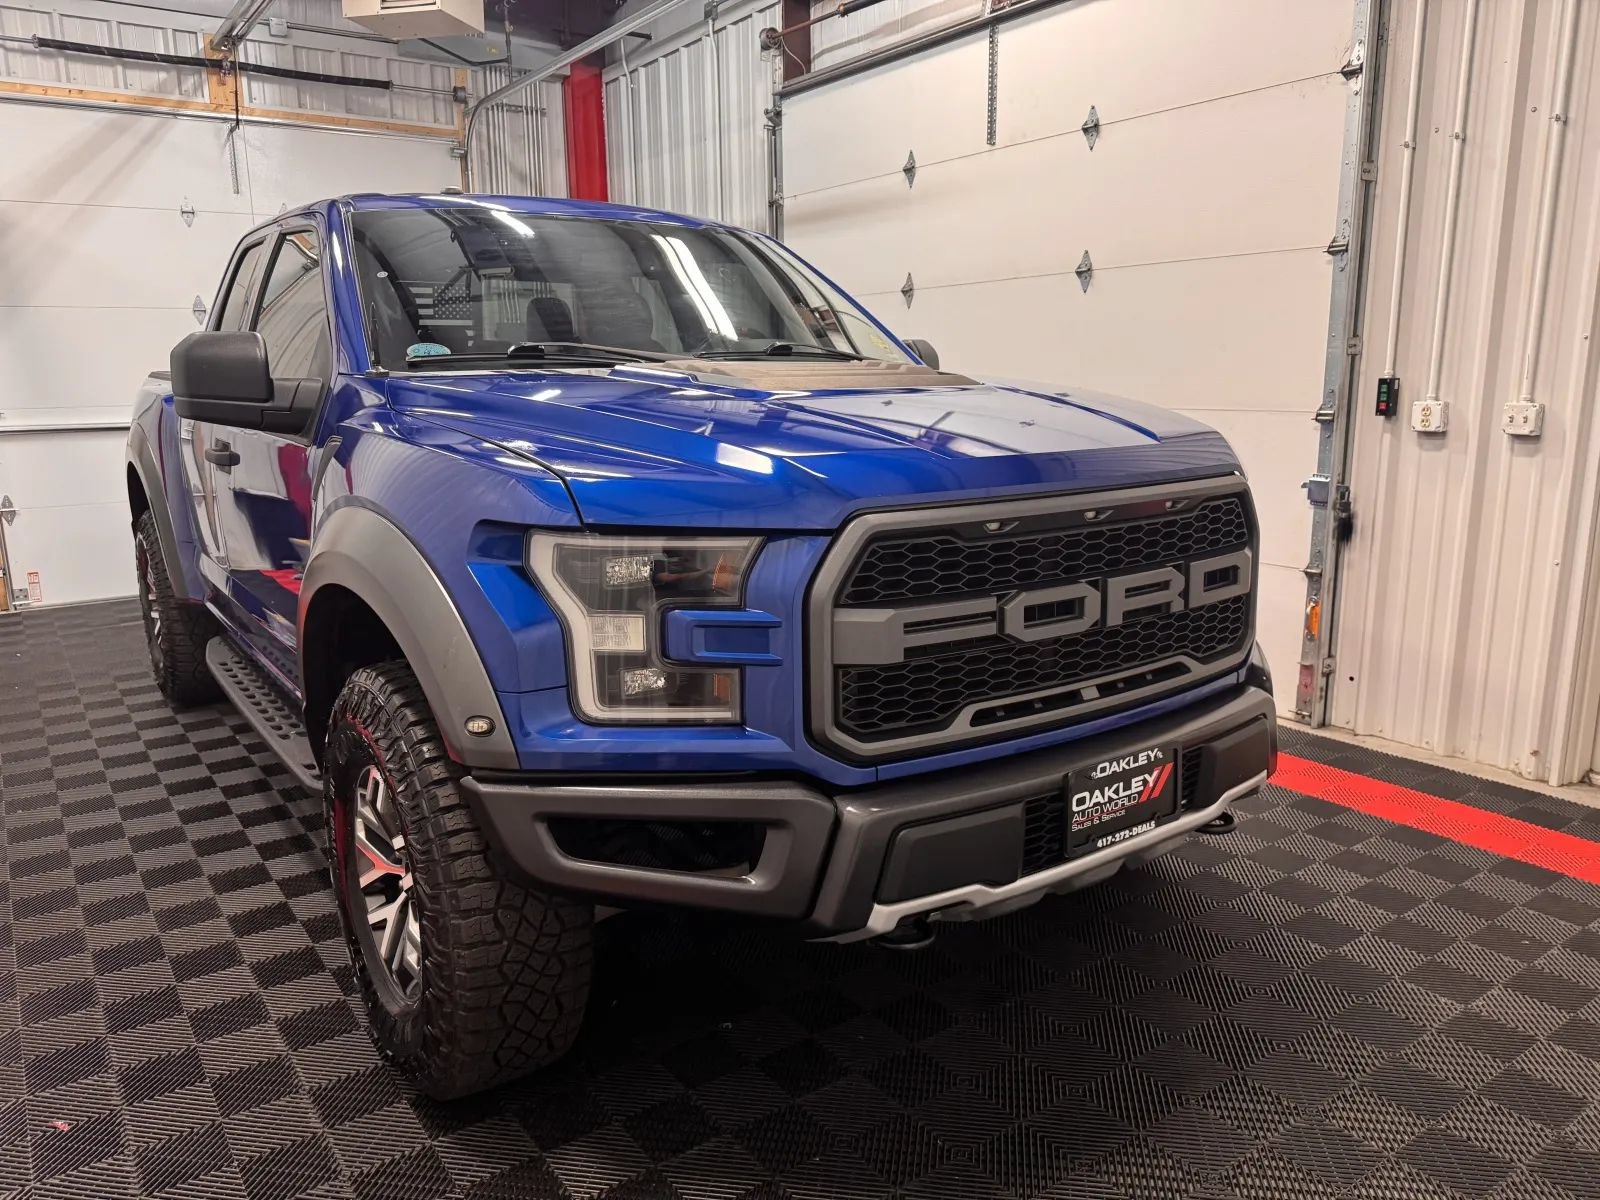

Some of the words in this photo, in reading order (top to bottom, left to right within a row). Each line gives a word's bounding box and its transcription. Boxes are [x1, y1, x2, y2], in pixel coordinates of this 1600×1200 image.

[833, 549, 1252, 664] FORD
[1096, 748, 1159, 779] OAKLEY
[1072, 771, 1158, 812] OAKLEY
[1072, 806, 1101, 823] AUTO
[1102, 794, 1138, 812] WORLD
[1097, 820, 1156, 848] 417-272-DEALS
